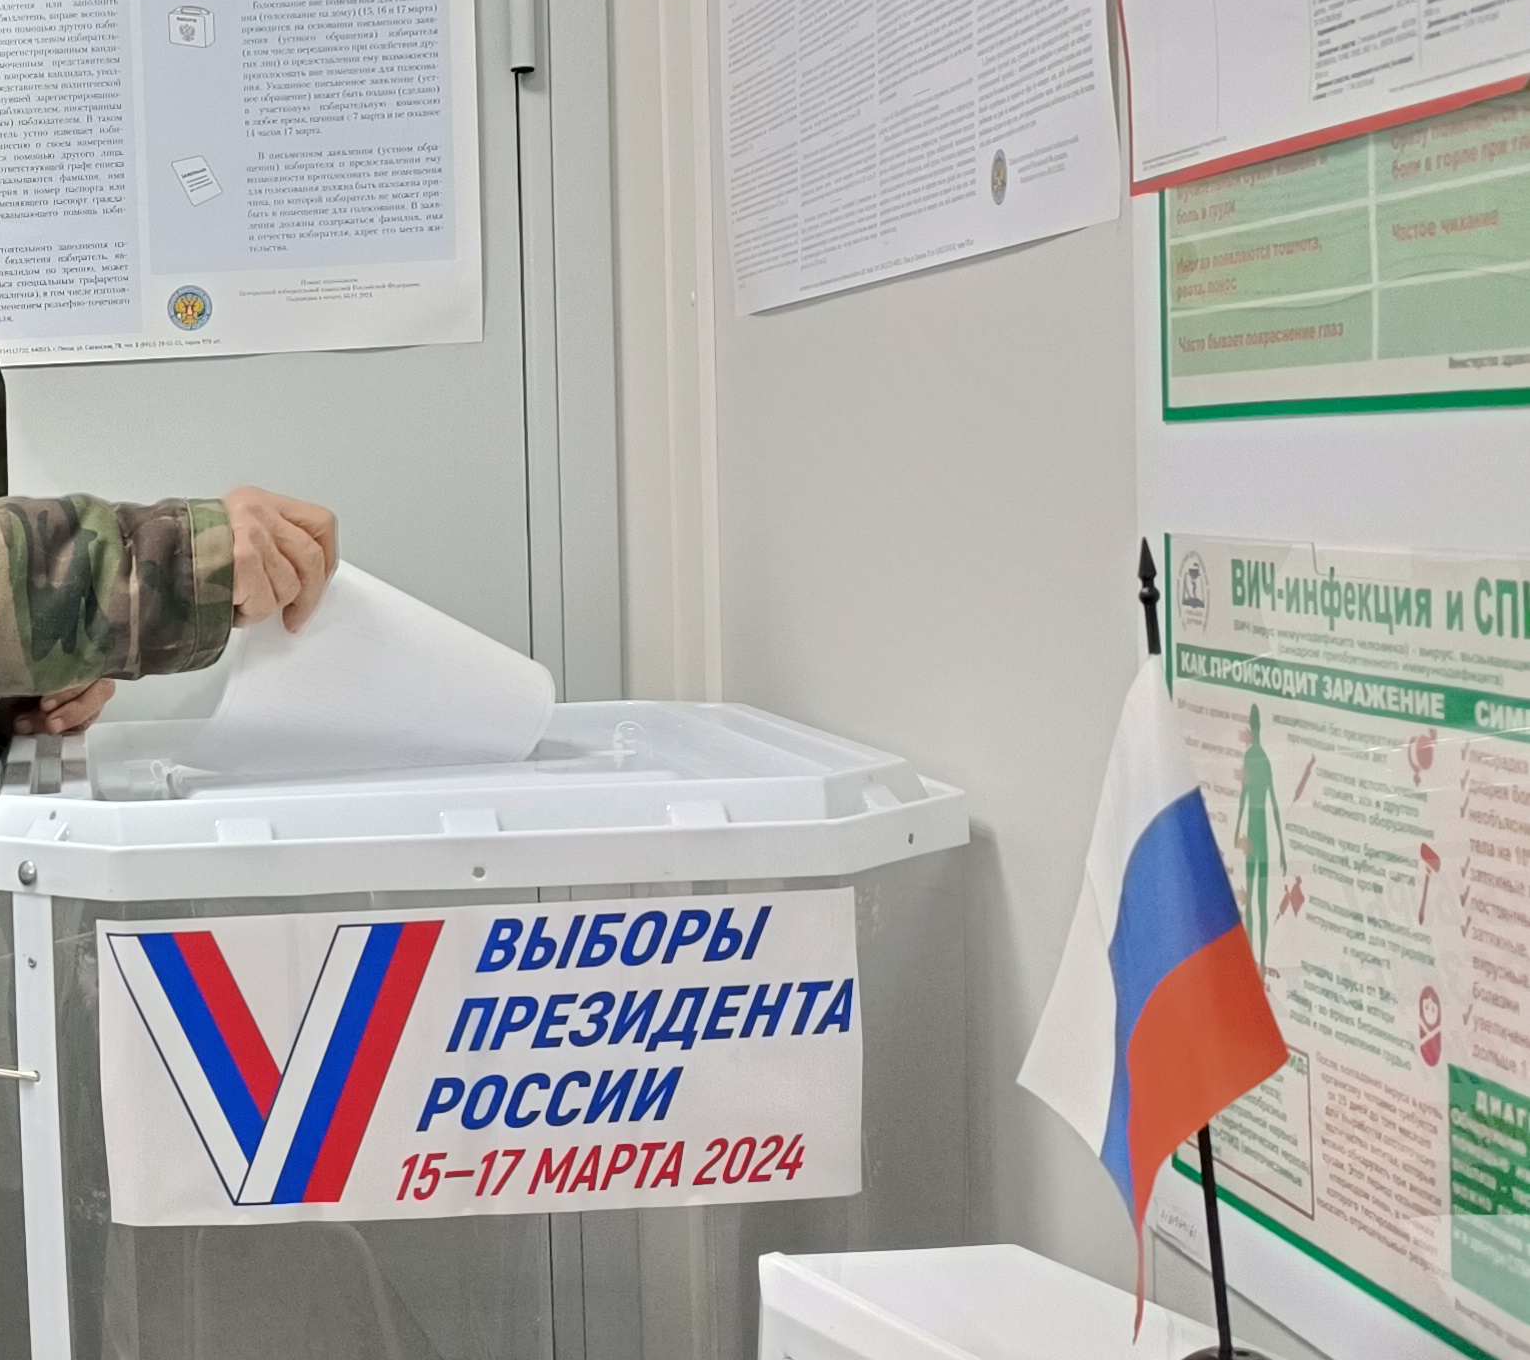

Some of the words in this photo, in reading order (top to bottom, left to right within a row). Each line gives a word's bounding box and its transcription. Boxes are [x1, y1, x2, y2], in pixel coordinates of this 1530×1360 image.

[1318, 322, 1344, 339] глаз
[1231, 559, 1432, 635] ВИЧ-инфекция
[1446, 589, 1464, 633] и
[1180, 651, 1207, 676] КАК
[1210, 654, 1320, 700] ПРОИСХОДИТ
[1322, 675, 1446, 720] ЗАРАЖЕНИЕ
[475, 905, 774, 975] ВЫБОРЫ
[445, 976, 854, 1054] ПРЕЗИДЕНТА
[415, 1066, 684, 1133] РОССИИ
[528, 1141, 685, 1196] МАРТА
[695, 1133, 807, 1187] 2024
